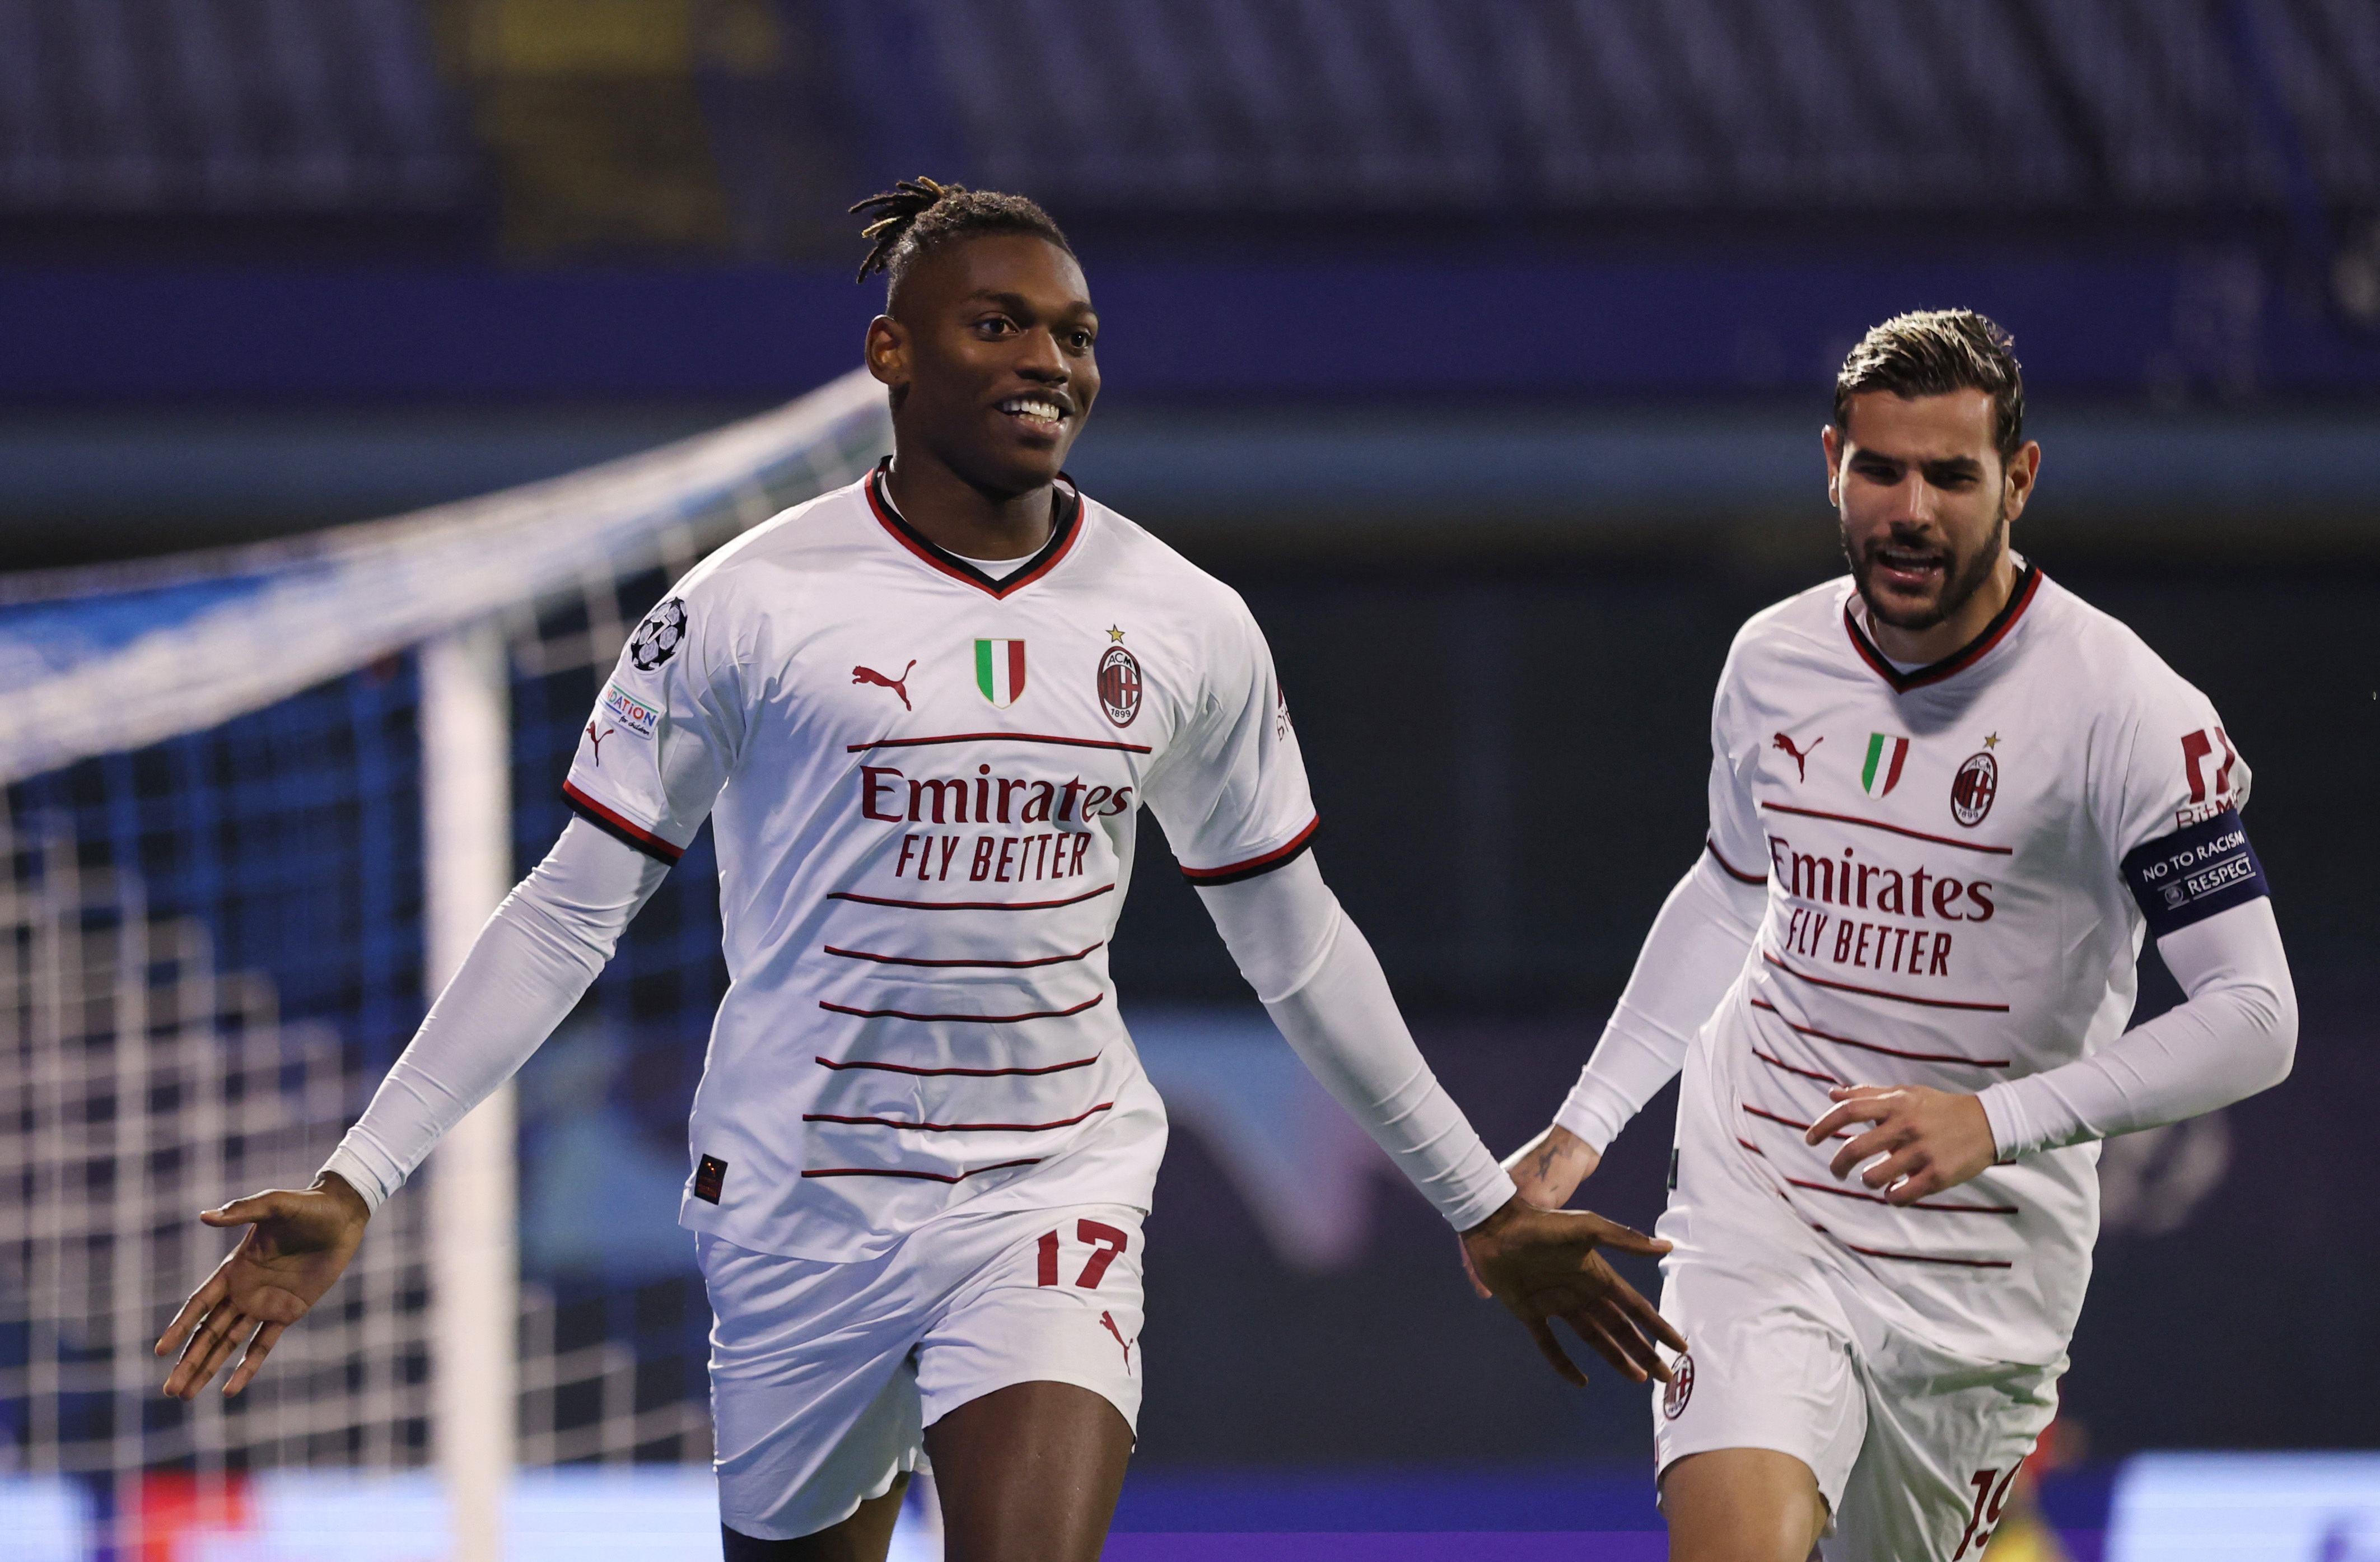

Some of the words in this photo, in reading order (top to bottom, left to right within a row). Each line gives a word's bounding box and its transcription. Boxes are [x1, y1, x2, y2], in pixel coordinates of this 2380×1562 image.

[1107, 652, 1132, 668] ACM
[1111, 708, 1131, 718] 1899
[859, 763, 1133, 824] Emirates
[895, 834, 960, 882] FLY
[969, 832, 1092, 883] BETTER
[1768, 833, 1995, 923] Emirates
[2143, 861, 2168, 882] NO
[2169, 851, 2194, 870] TO
[2196, 830, 2245, 861] RACISM
[2187, 857, 2251, 896] RESPECT
[1786, 908, 1828, 958] FLY
[1833, 920, 1952, 977] BETTER
[1038, 1218, 1128, 1289] 17
